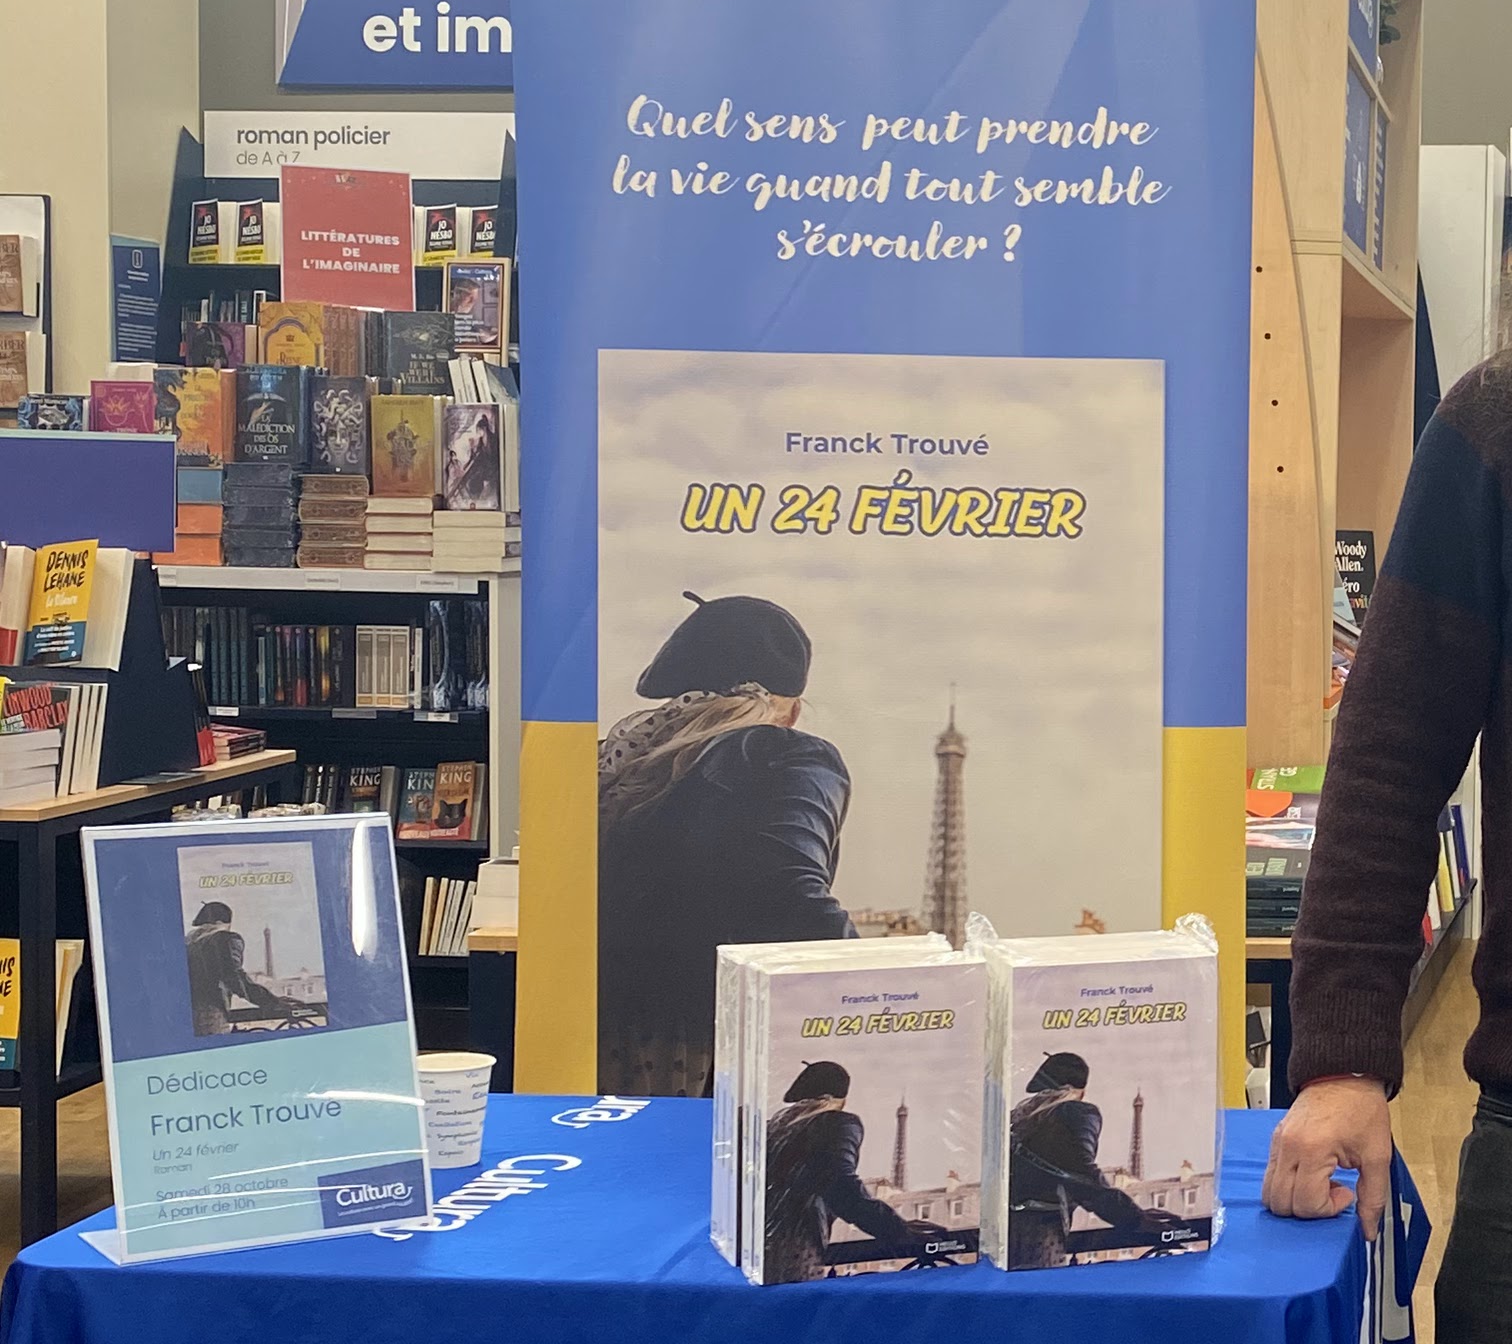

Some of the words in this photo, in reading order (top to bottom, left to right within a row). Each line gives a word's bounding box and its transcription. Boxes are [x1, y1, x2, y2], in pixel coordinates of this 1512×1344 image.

[362, 6, 422, 54] et
[626, 94, 737, 142] Quel
[744, 112, 847, 146] sens
[861, 109, 969, 154] peut
[976, 107, 1159, 154] prendre
[236, 127, 309, 145] roman
[313, 125, 391, 151] policier
[236, 151, 258, 165] de
[262, 151, 273, 165] A
[612, 155, 661, 198] la
[670, 161, 737, 198] vie
[742, 161, 891, 211] quand
[902, 168, 1005, 205] tout
[1014, 167, 1173, 208] semble
[300, 229, 400, 246] LITTÉRATURES
[775, 219, 988, 262] s'écrouler
[1003, 225, 1023, 262] ?
[342, 248, 361, 258] DE
[302, 260, 400, 274] L'IMAGINAIRE
[785, 430, 882, 455] Franck
[889, 432, 990, 457] Trouvé
[681, 484, 765, 534] UN
[770, 486, 839, 536] 24
[849, 470, 1087, 540] FÉVRIER
[46, 549, 89, 572] DENNIS
[43, 570, 86, 593] LEHANE
[1341, 575, 1361, 594] éro
[349, 773, 381, 787] KING
[439, 771, 472, 785] KING
[841, 994, 879, 1004] Franck
[882, 991, 920, 1002] Trouvé
[1080, 987, 1117, 998] Franck
[1118, 983, 1155, 996] Trouvé
[802, 1018, 830, 1038] UN
[835, 1015, 862, 1036] 24
[866, 1006, 955, 1034] FÉVRIER
[1042, 1010, 1071, 1030] UN
[1074, 1007, 1101, 1027] 24
[1103, 998, 1187, 1026] FÉVRIER
[146, 1068, 268, 1096] Dédicace
[149, 1106, 244, 1136] Franck
[152, 1147, 171, 1162] Un
[175, 1145, 193, 1160] 24
[196, 1141, 240, 1157] février
[155, 1182, 210, 1202] Samedi
[214, 1182, 231, 1197] 28
[234, 1176, 289, 1193] octobre
[335, 1181, 413, 1208] Cultura
[170, 1202, 210, 1223] partir
[212, 1199, 230, 1214] de
[233, 1196, 256, 1212] 10h
